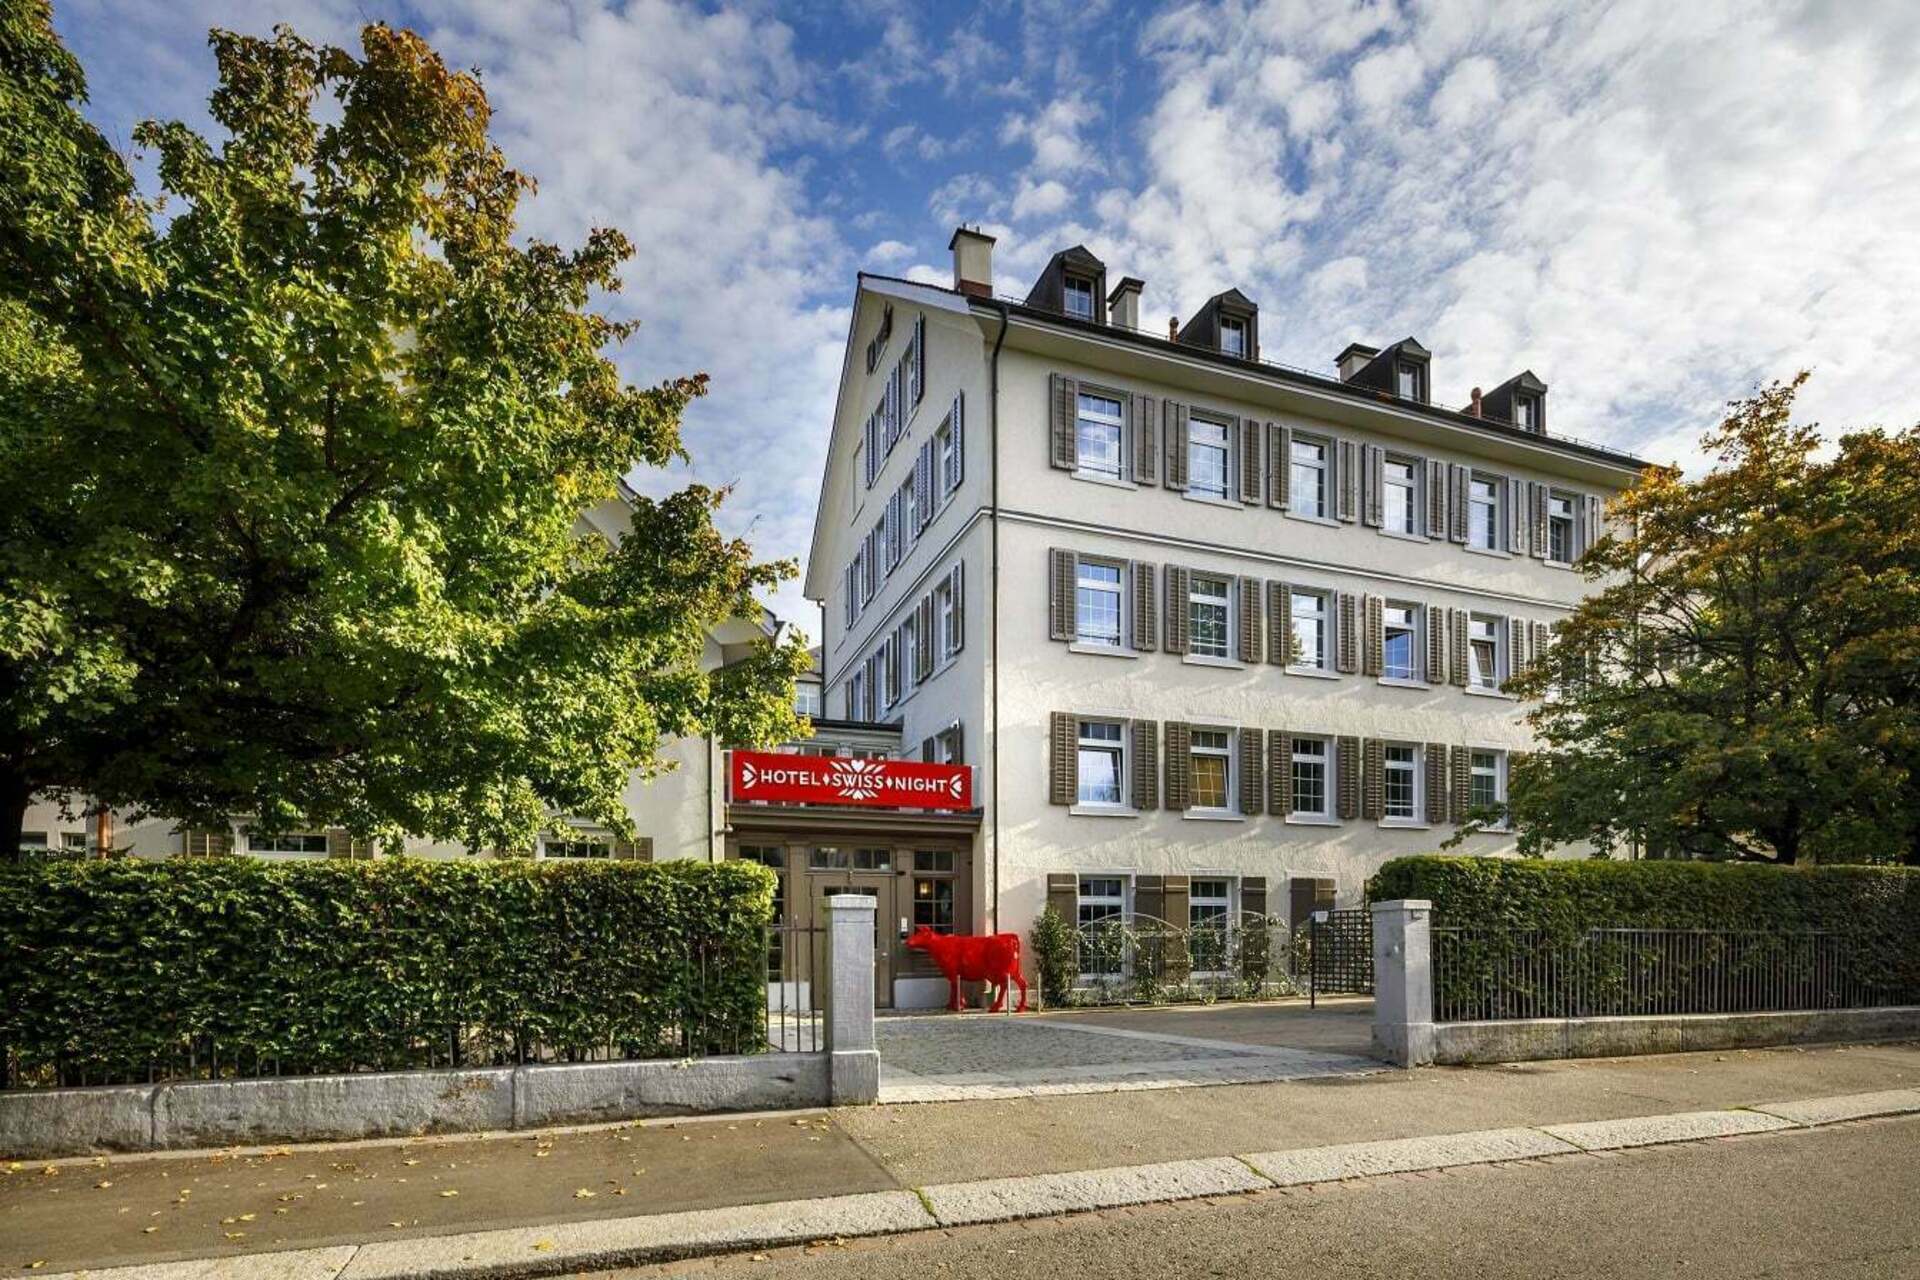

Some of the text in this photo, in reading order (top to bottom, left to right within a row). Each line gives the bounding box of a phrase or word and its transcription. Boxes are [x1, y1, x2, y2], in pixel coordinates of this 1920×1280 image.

[760, 769, 948, 792] HOTEL SWISS NIGHT
